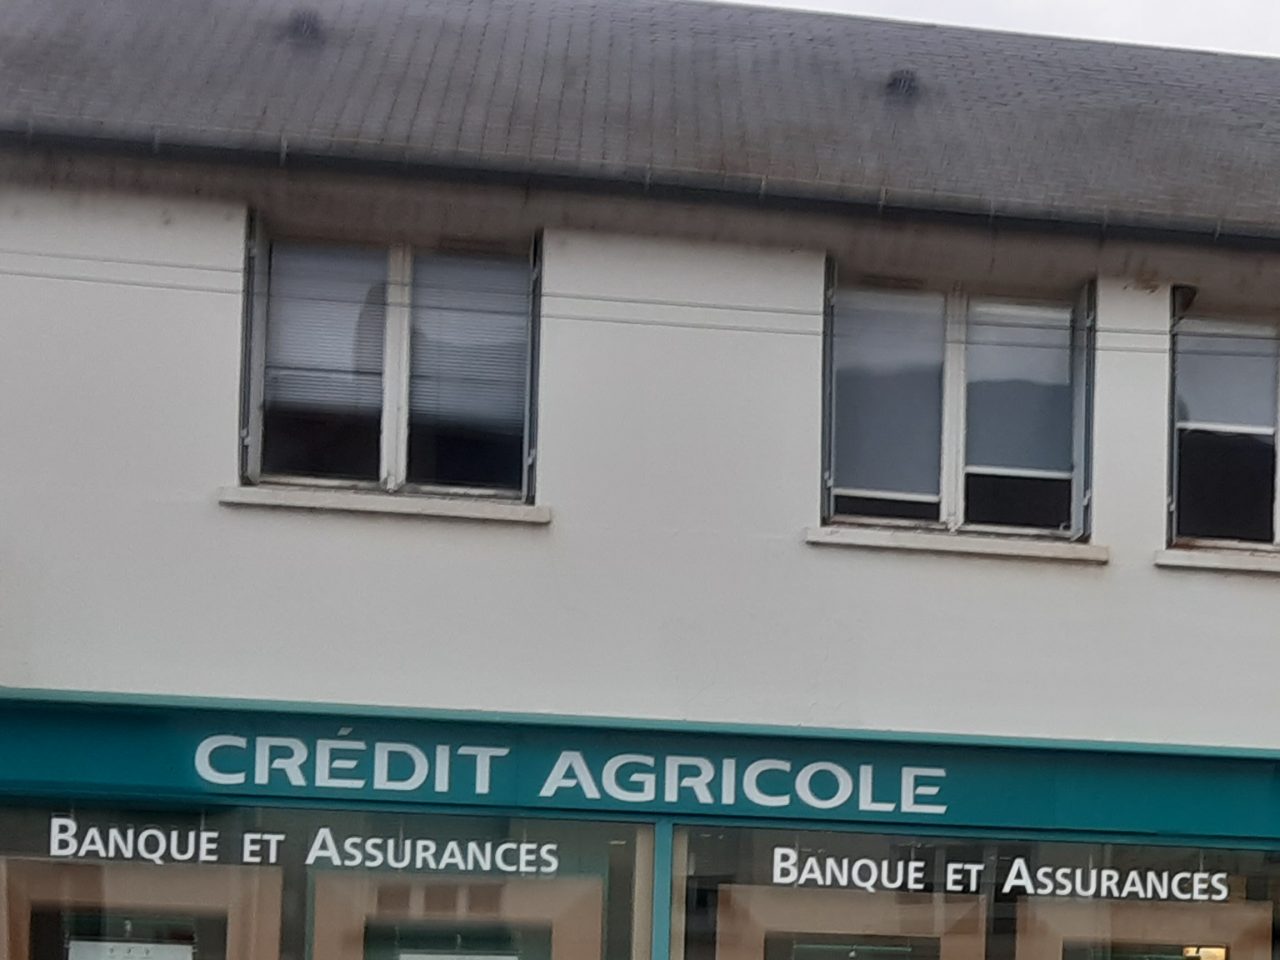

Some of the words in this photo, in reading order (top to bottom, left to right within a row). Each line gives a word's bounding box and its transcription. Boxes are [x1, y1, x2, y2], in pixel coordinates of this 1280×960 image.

[194, 727, 510, 794] CRÉDIT
[538, 750, 948, 815] AGRICOLE
[50, 817, 219, 865] BANQUE
[242, 833, 286, 864] ET
[304, 827, 559, 873] ASSURANCES
[772, 847, 925, 893] BANQUE
[946, 862, 985, 892] ET
[1001, 857, 1229, 901] ASSURANCES
